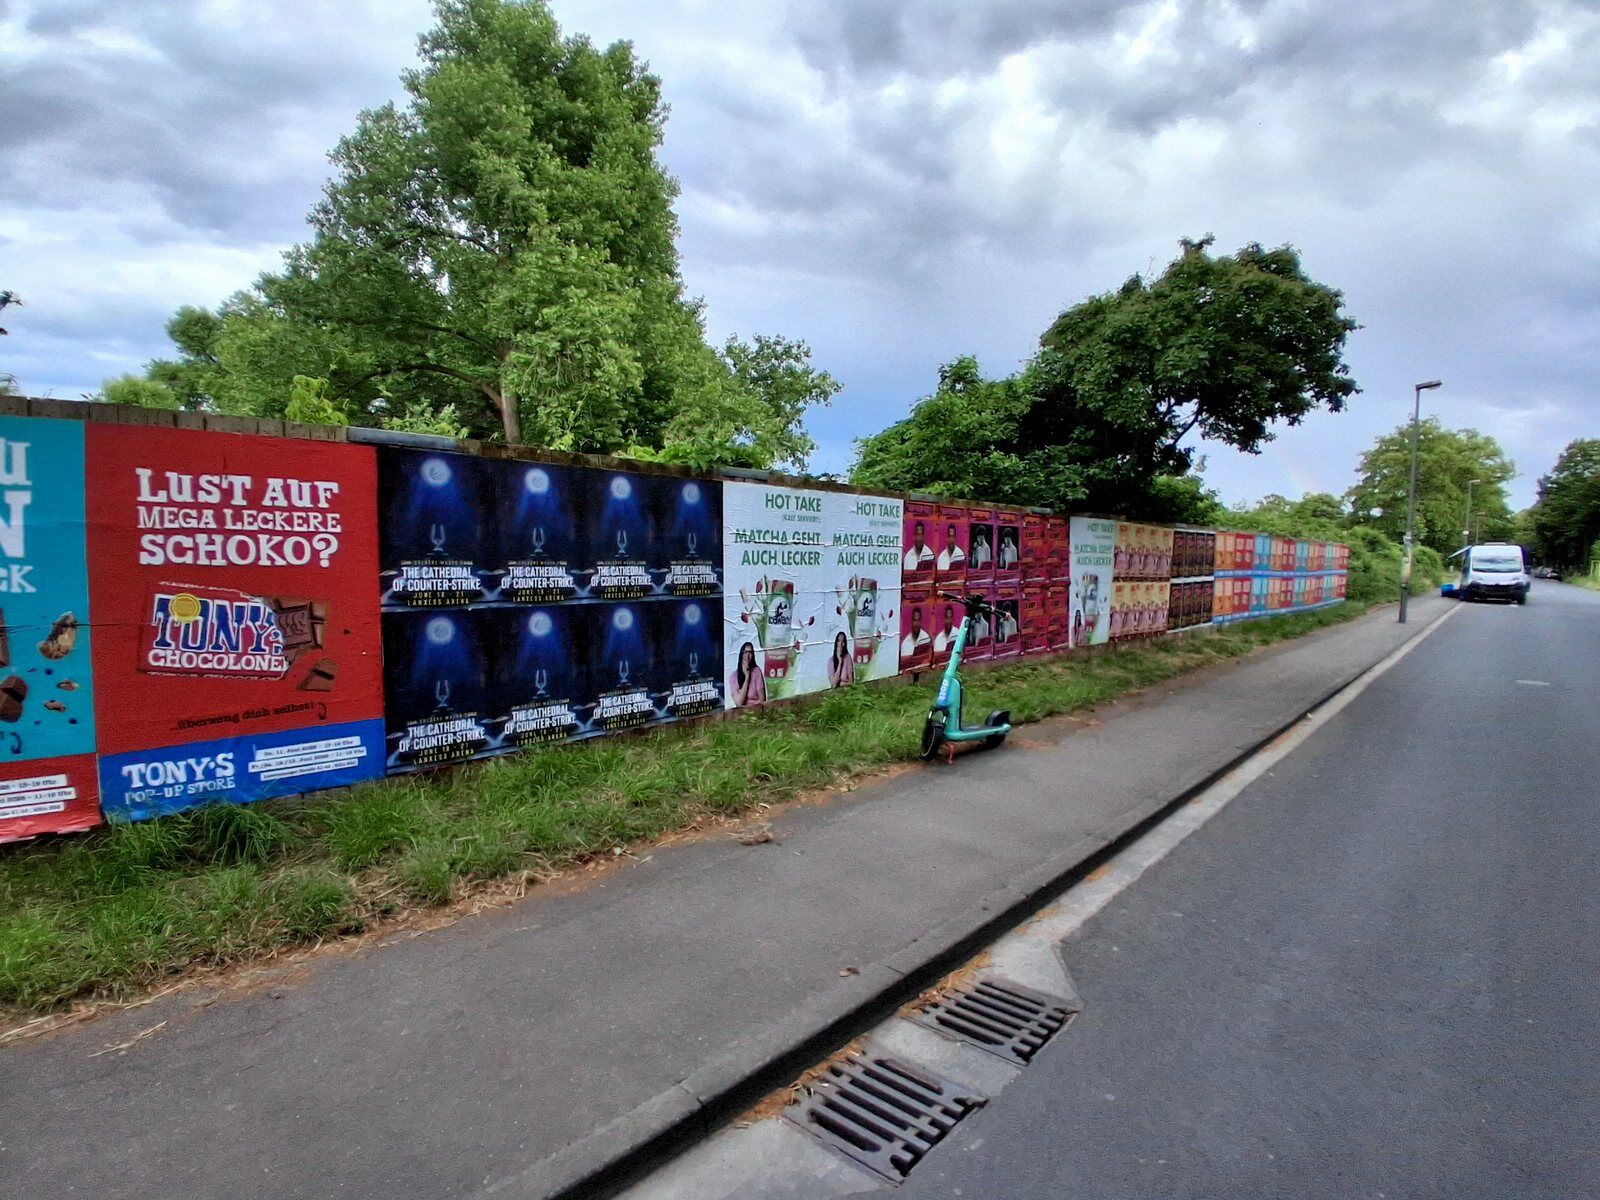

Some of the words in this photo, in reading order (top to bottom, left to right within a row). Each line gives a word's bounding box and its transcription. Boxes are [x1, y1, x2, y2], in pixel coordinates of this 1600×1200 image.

[135, 467, 252, 506] LUST
[261, 478, 339, 509] AUF
[765, 493, 791, 510] HOT
[794, 496, 822, 513] TAKE
[856, 502, 876, 517] HOT
[878, 504, 900, 518] TAKE
[136, 506, 217, 529] MEGA
[223, 508, 342, 533] LECKERE
[734, 529, 788, 545] MATCHA
[792, 530, 822, 545] GEHT
[833, 533, 873, 546] MATCHA
[876, 534, 900, 546] GEHT
[139, 533, 339, 568] SCHOKO?
[741, 550, 778, 566] AUCH
[781, 550, 821, 566] LECKER
[837, 551, 865, 566] AUCH
[868, 552, 899, 566] LECKER
[401, 566, 420, 579] THE
[422, 566, 472, 579] CATHEDRAL
[508, 566, 524, 577] THE
[525, 566, 567, 577] CATHEDRAL
[597, 566, 609, 576] THE
[611, 566, 646, 576] CATHEDRAL
[392, 579, 405, 592] OF
[407, 578, 481, 592] COUNTER-STRIKE
[501, 577, 511, 589] OF
[513, 576, 575, 589] COUNTER-STRIKE
[590, 576, 600, 587] OF
[601, 575, 652, 587] COUNTER-STRIKE
[599, 696, 613, 708] THE
[614, 692, 648, 707] CATHEDRAL
[512, 710, 527, 723] THE
[528, 704, 570, 719] CATHEDRAL
[603, 700, 654, 718] COUNTER-STRIKE
[408, 724, 426, 738] THE
[427, 718, 476, 736] CATHEDRAL
[504, 722, 515, 735] OF
[516, 713, 576, 732] COUNTER-STRIKE
[398, 739, 411, 752] OF
[413, 727, 485, 750] COUNTER-STRIKE
[121, 752, 235, 789] TONY'S
[125, 784, 185, 805] POP-UP
[187, 776, 236, 795] STORE
